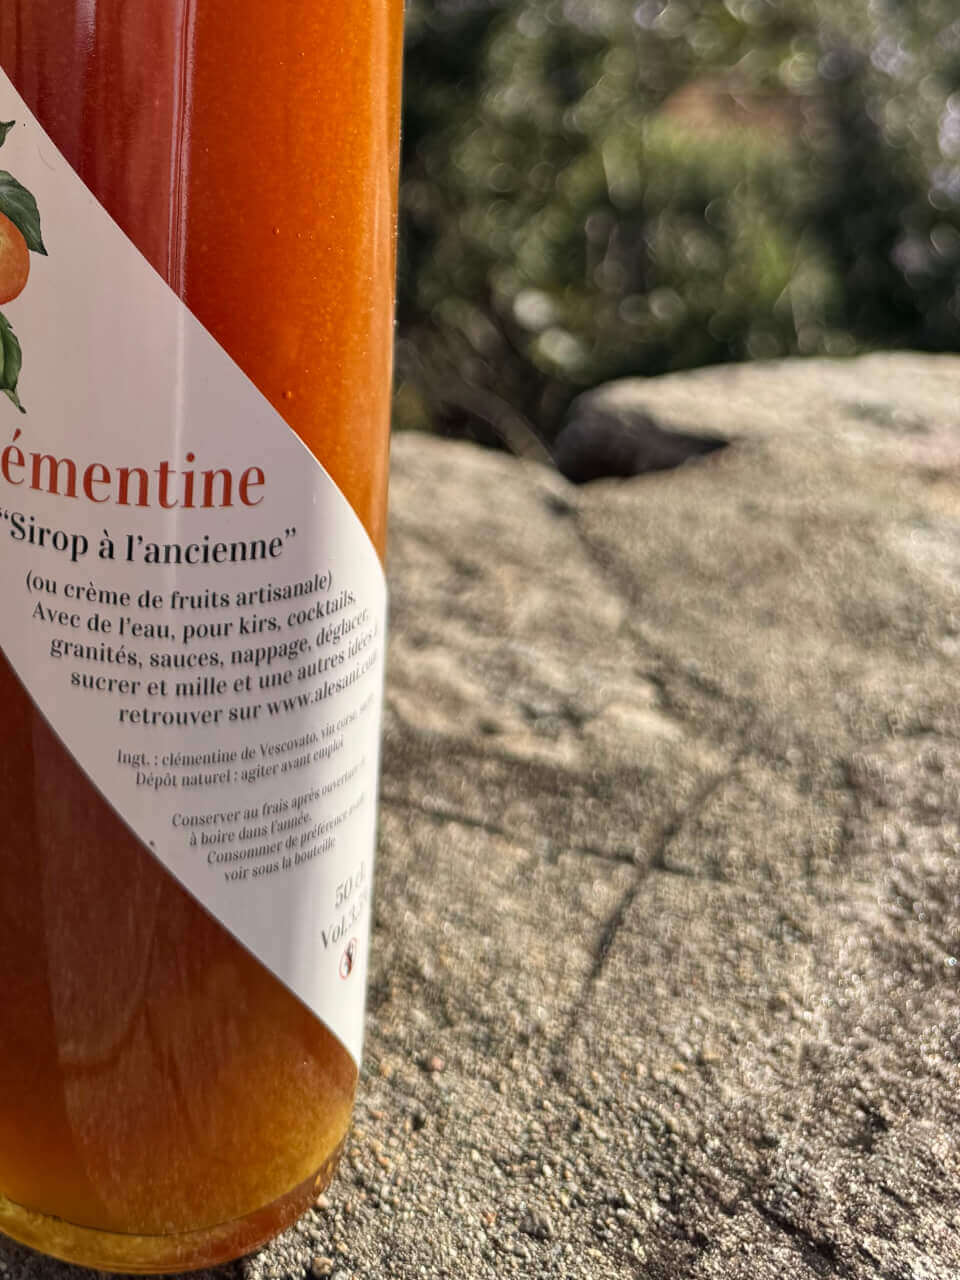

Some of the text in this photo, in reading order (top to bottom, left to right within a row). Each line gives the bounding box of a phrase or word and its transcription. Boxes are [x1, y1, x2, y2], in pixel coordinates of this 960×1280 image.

[98, 529, 116, 561] à
[125, 527, 297, 565] l’ancienne”
[25, 569, 333, 609] (ou crème de fruits artisanale)
[32, 589, 357, 645] Avec de l’eau, pour kirs, cocktails,
[49, 636, 143, 669] granités,
[149, 650, 224, 669] sauces,
[230, 635, 313, 669] nappage,
[70, 671, 141, 696] sucrer
[146, 678, 169, 697] et
[175, 675, 227, 697] mille
[233, 674, 252, 692] et
[258, 670, 293, 690] une
[296, 650, 345, 682] autres
[118, 705, 224, 726] retrouver
[228, 702, 262, 722] sur
[161, 747, 238, 767] clémentine
[240, 745, 256, 761] de
[258, 733, 319, 757] Vescovato,
[321, 722, 336, 738] vin
[134, 770, 178, 791] Dépôt
[180, 769, 231, 788] naturel
[240, 764, 280, 785] agiter
[280, 755, 311, 772] avant
[171, 810, 240, 828] Conserver
[242, 807, 259, 820] au
[261, 798, 289, 820] frais
[290, 788, 321, 812] après
[189, 830, 197, 846] à
[200, 829, 236, 846] boire
[238, 824, 268, 840] dans
[206, 841, 283, 865] Consommer
[285, 835, 298, 850] de
[223, 836, 336, 882] voir sous la bouteille
